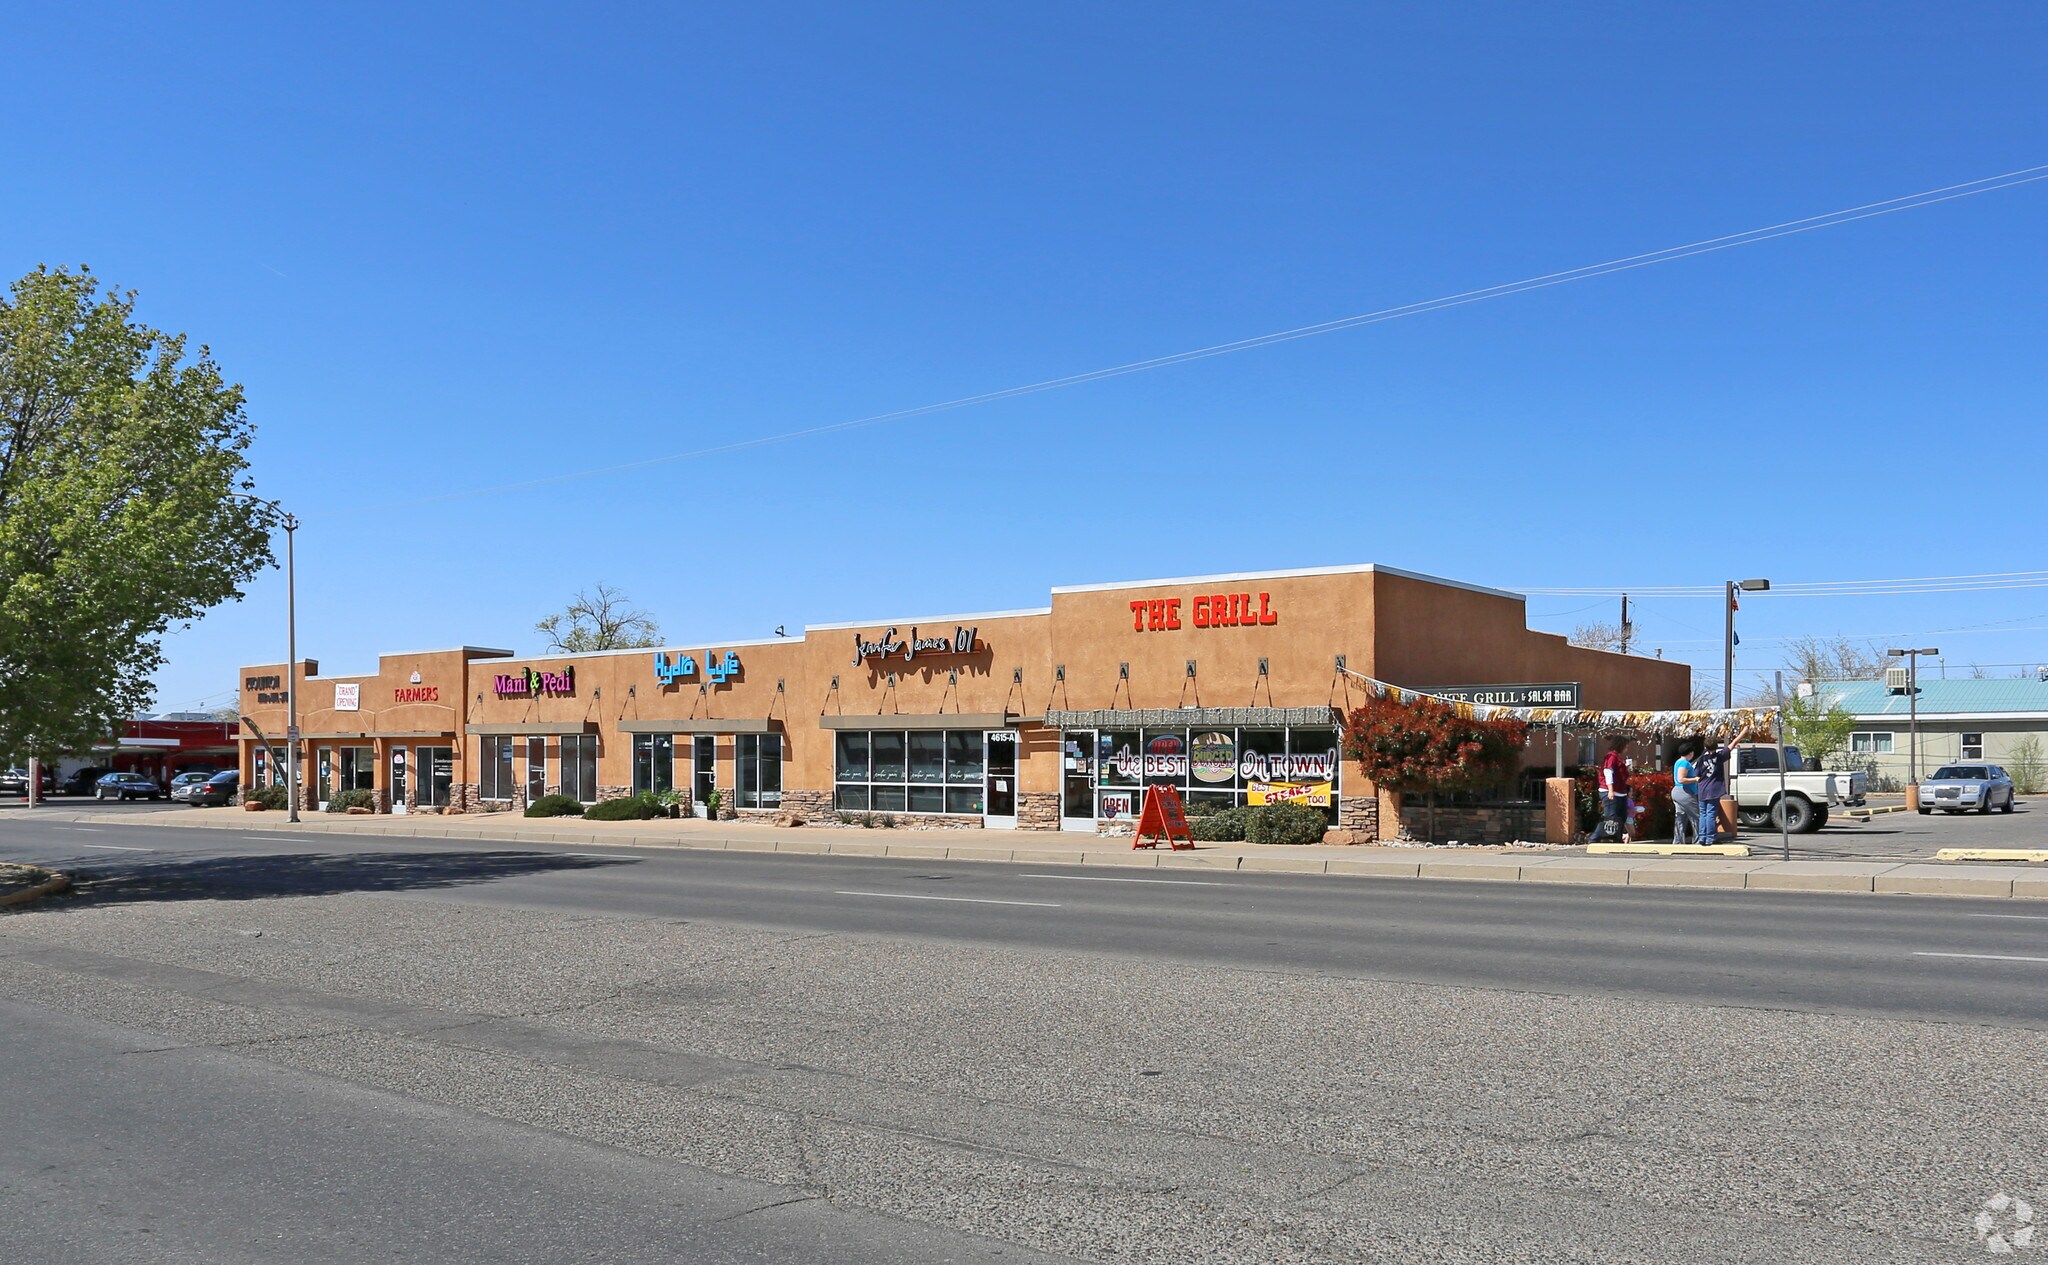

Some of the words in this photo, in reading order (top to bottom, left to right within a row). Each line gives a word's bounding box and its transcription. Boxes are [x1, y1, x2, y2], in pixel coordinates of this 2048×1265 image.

[1130, 599, 1181, 632] THE
[1193, 592, 1277, 628] GRILL
[904, 626, 947, 661] James
[951, 626, 977, 653] 101
[705, 650, 739, 689] Lyfe
[494, 667, 528, 694] Mani
[530, 671, 541, 689] &
[542, 665, 572, 692] Pedi
[336, 697, 357, 707] OPENING
[394, 686, 439, 703] FARMERS
[1473, 692, 1519, 704] GRILL
[1527, 690, 1552, 702] SALSA
[1553, 690, 1572, 702] BAR
[991, 733, 1015, 742] 4615-A
[1109, 744, 1141, 779] the
[1144, 754, 1187, 777] BEST
[1240, 749, 1270, 782] In
[1268, 748, 1336, 781] TOWN!
[1251, 783, 1271, 792] BEST
[1264, 783, 1313, 804] STEAKS
[1102, 796, 1130, 813] OPEN
[1307, 795, 1328, 804] TOO!
